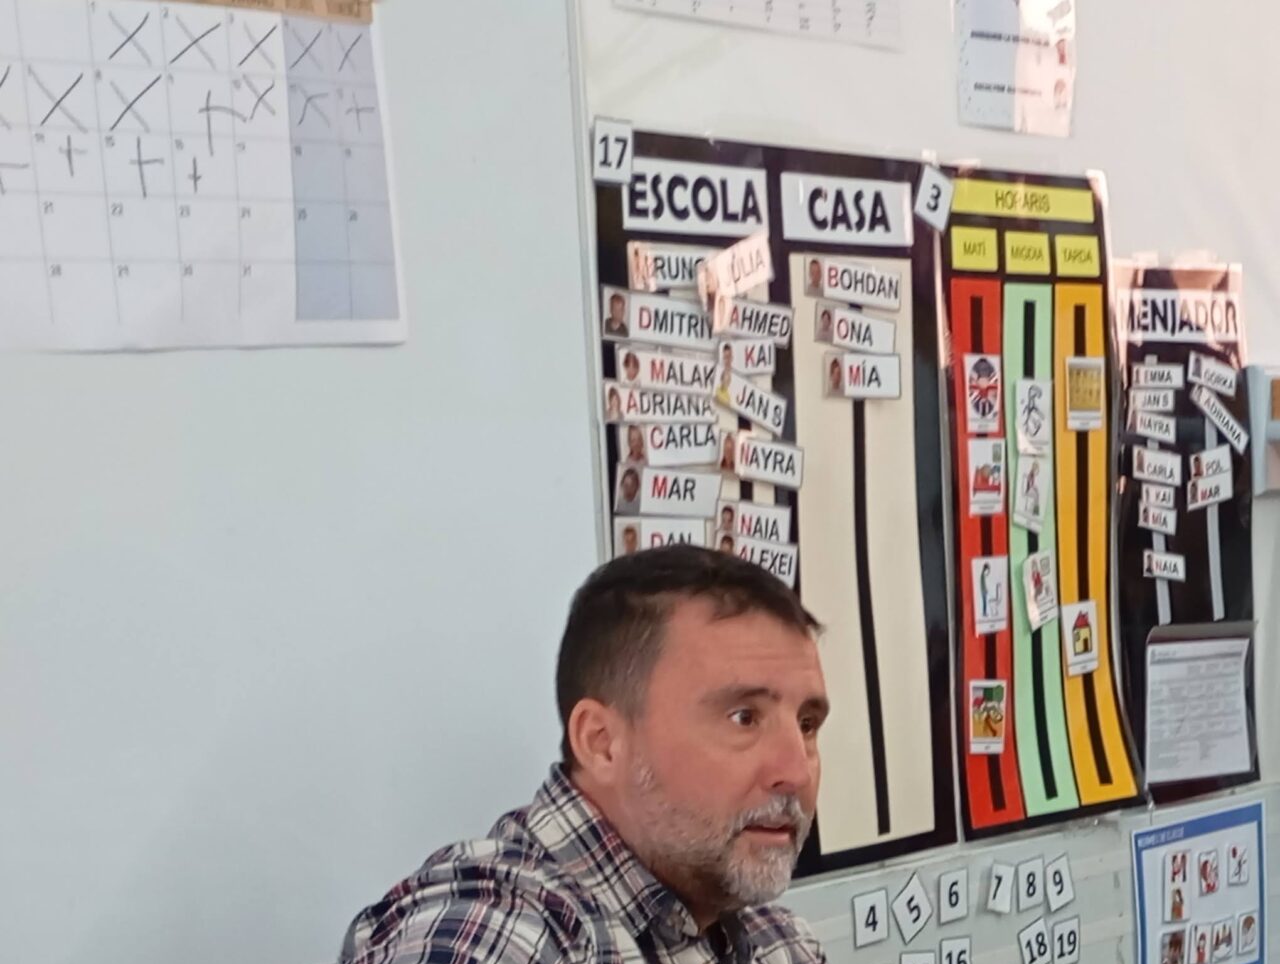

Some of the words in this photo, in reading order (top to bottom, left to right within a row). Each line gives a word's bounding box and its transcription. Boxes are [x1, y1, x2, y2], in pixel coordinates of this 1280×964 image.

[598, 133, 629, 170] 17
[628, 172, 763, 224] ESCOLA
[808, 186, 891, 233] CASA
[926, 183, 942, 212] 3
[827, 266, 899, 300] BOHDAN
[730, 305, 791, 337] AHMED
[836, 317, 874, 347] ONA
[744, 342, 772, 368] KAI
[848, 359, 882, 388] MÍA
[625, 389, 714, 416] ADRIANA
[736, 384, 770, 421] JAN
[650, 423, 717, 450] CARLA
[740, 440, 796, 477] NAYRA
[651, 473, 697, 502] MAR
[740, 513, 780, 542] NAIA
[864, 904, 879, 932] 4
[906, 894, 921, 925] 5
[949, 880, 960, 909] 6
[991, 874, 1003, 901] 7
[1025, 872, 1036, 898] 8
[1052, 869, 1064, 896] 9
[1056, 929, 1077, 960] 19
